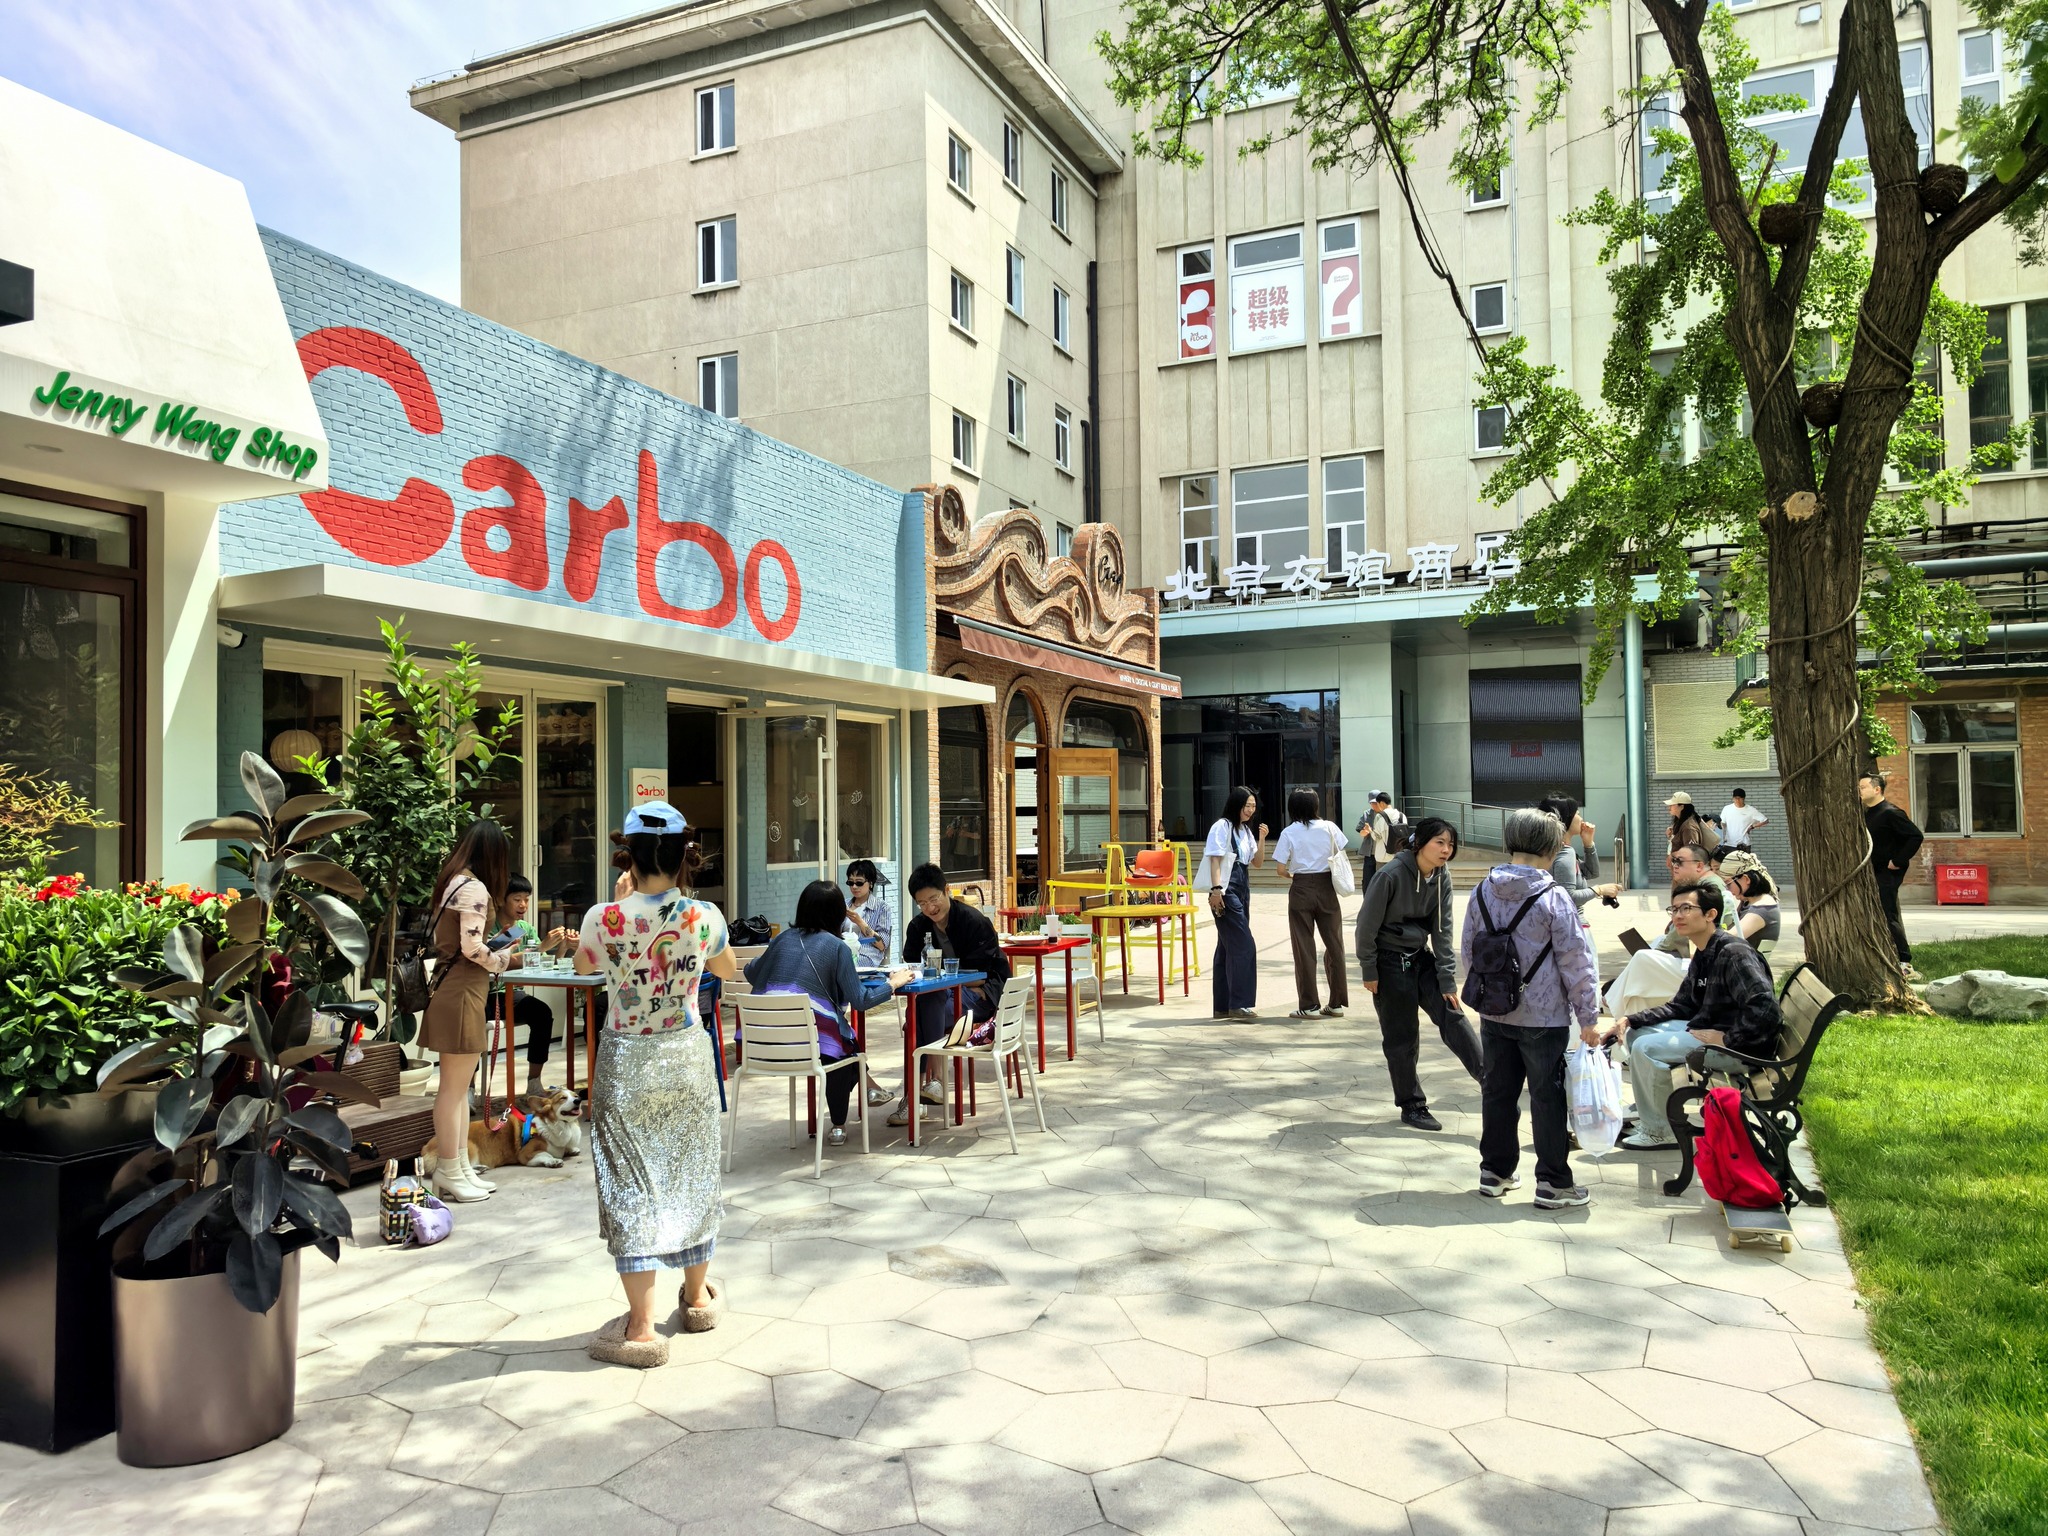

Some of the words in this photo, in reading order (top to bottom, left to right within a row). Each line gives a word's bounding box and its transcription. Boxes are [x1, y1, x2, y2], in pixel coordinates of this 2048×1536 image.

[1248, 285, 1289, 310] 超级
[1248, 307, 1290, 332] 转转
[1190, 334, 1208, 342] FLOOR
[35, 371, 149, 434] Jenny
[154, 402, 241, 463] Wang
[245, 427, 318, 480] Shop
[295, 326, 802, 642] Carbo
[1164, 534, 1521, 601] 北京友谊商店
[636, 783, 666, 797] Carbo
[634, 955, 698, 986] TRYING
[652, 978, 675, 996] MY
[648, 995, 686, 1014] BEST
